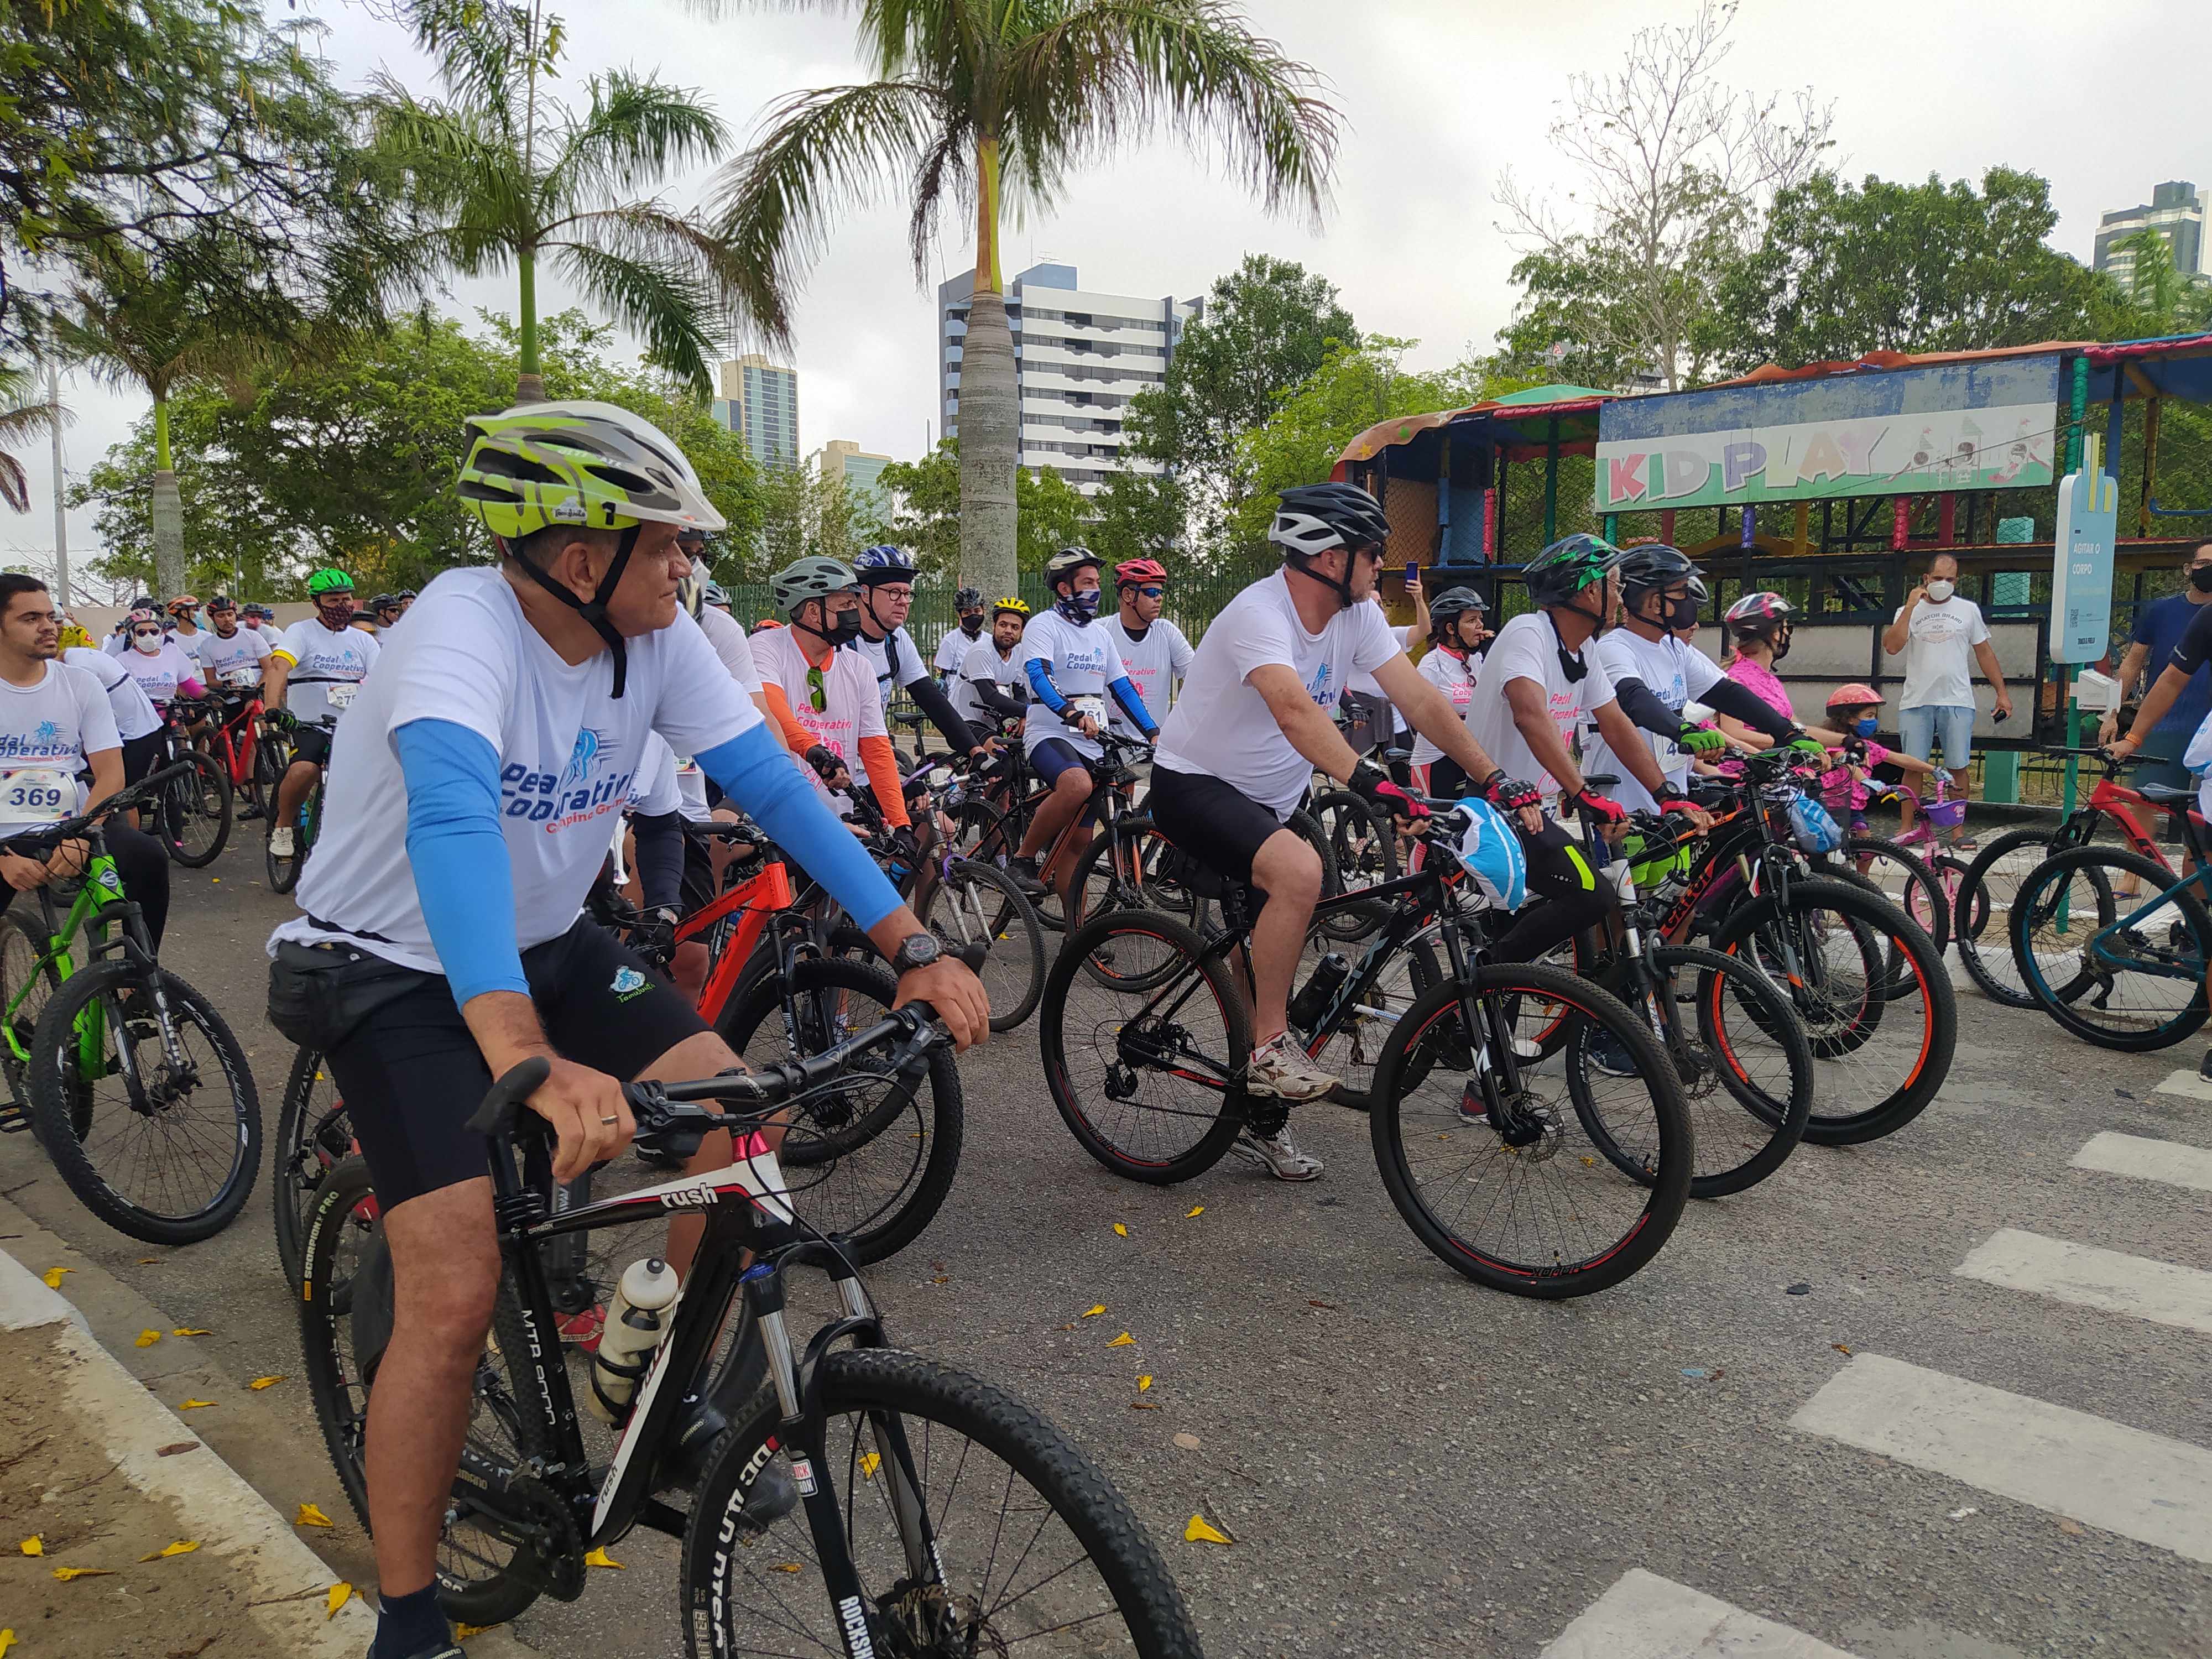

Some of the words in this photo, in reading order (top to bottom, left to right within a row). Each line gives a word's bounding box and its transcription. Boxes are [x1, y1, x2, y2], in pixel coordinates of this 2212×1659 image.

[1608, 449, 1710, 505] KID
[1722, 426, 1890, 493] PLAY
[2073, 543, 2094, 554] AGITAR
[2095, 543, 2100, 554] O
[2072, 564, 2092, 575] CORPO
[1915, 613, 1940, 626] AVIATOR
[1942, 613, 1963, 624] BRAND
[314, 654, 340, 663] Pedal
[1067, 653, 1092, 662] Pedal
[1066, 661, 1106, 672] Cooperati
[0, 734, 26, 746] dal
[9, 787, 61, 806] 369
[660, 1183, 719, 1208] rush
[305, 1221, 322, 1279] SCORPION
[319, 1191, 339, 1214] PRO
[528, 1223, 554, 1235] CARBON
[794, 1464, 810, 1478] OCK
[601, 1464, 618, 1505] rush
[839, 1595, 876, 1659] ROCKSH
